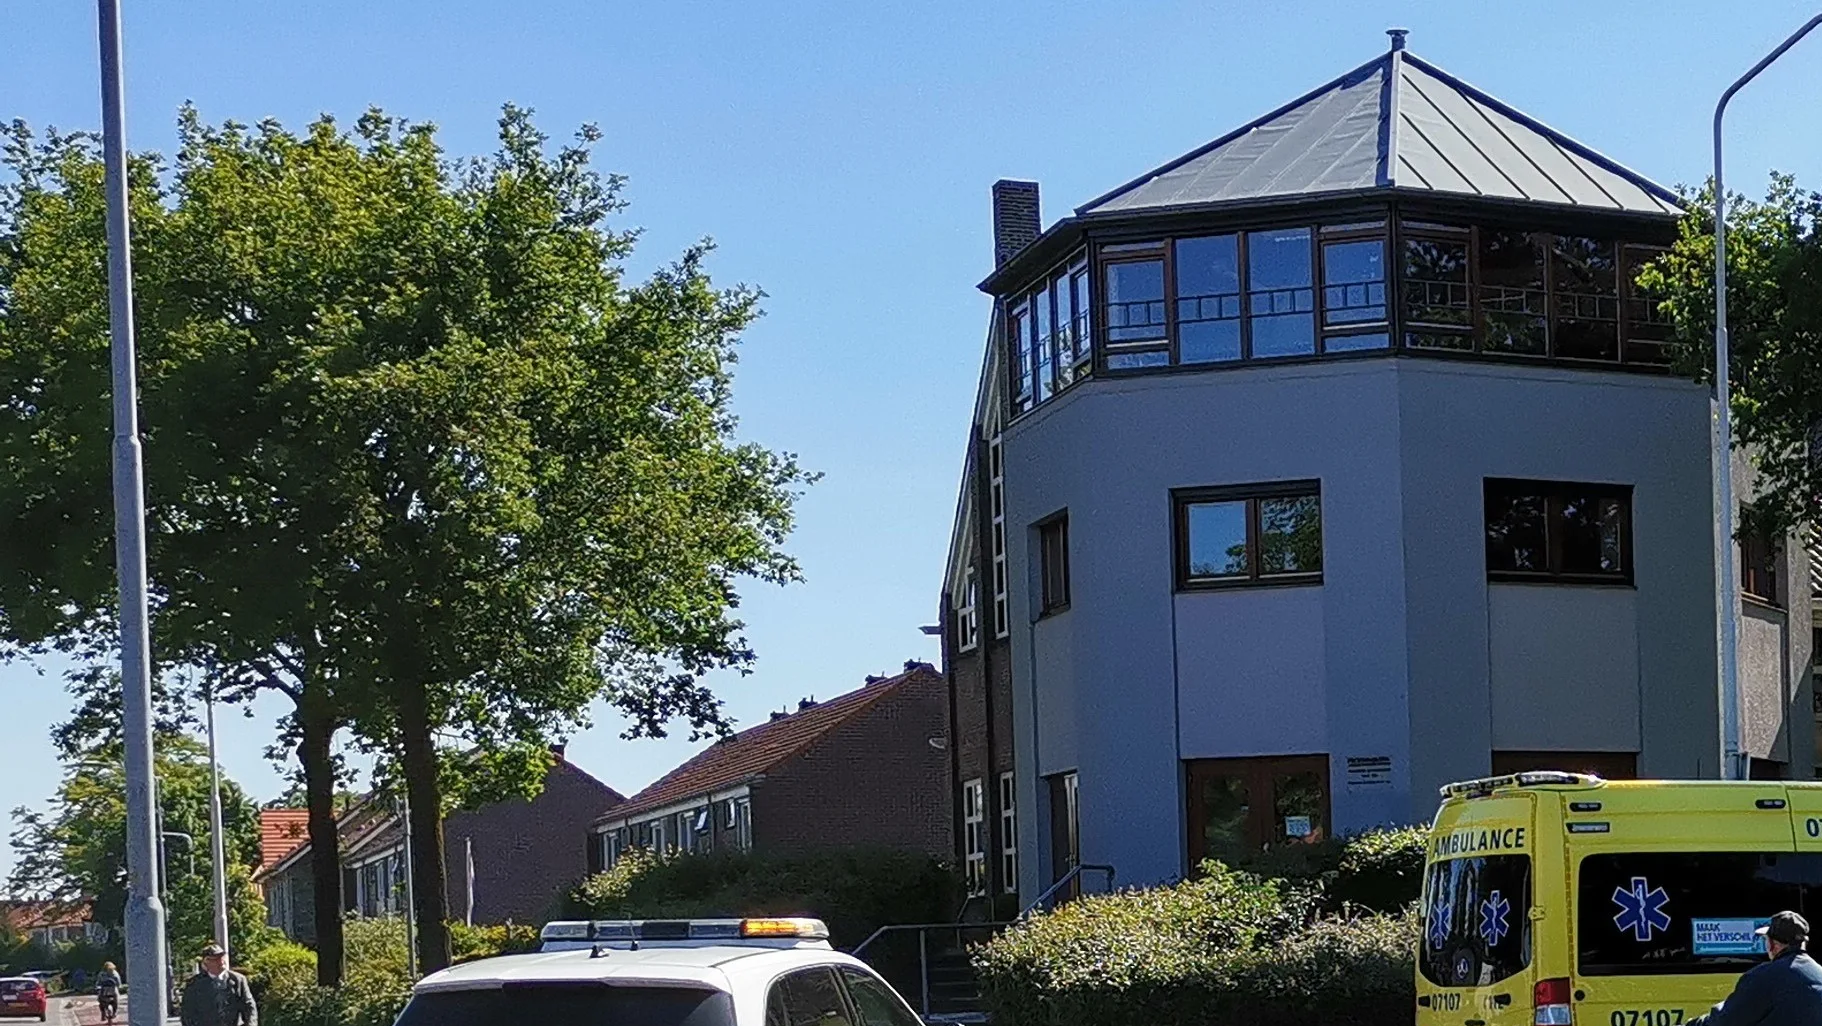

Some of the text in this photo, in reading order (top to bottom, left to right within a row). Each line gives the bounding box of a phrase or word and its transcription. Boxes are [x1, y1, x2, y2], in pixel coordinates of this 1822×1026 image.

[1433, 827, 1525, 857] AMBULANCE
[1696, 923, 1720, 932] MAAK
[1696, 932, 1713, 942] HET
[1431, 993, 1460, 1012] 07107
